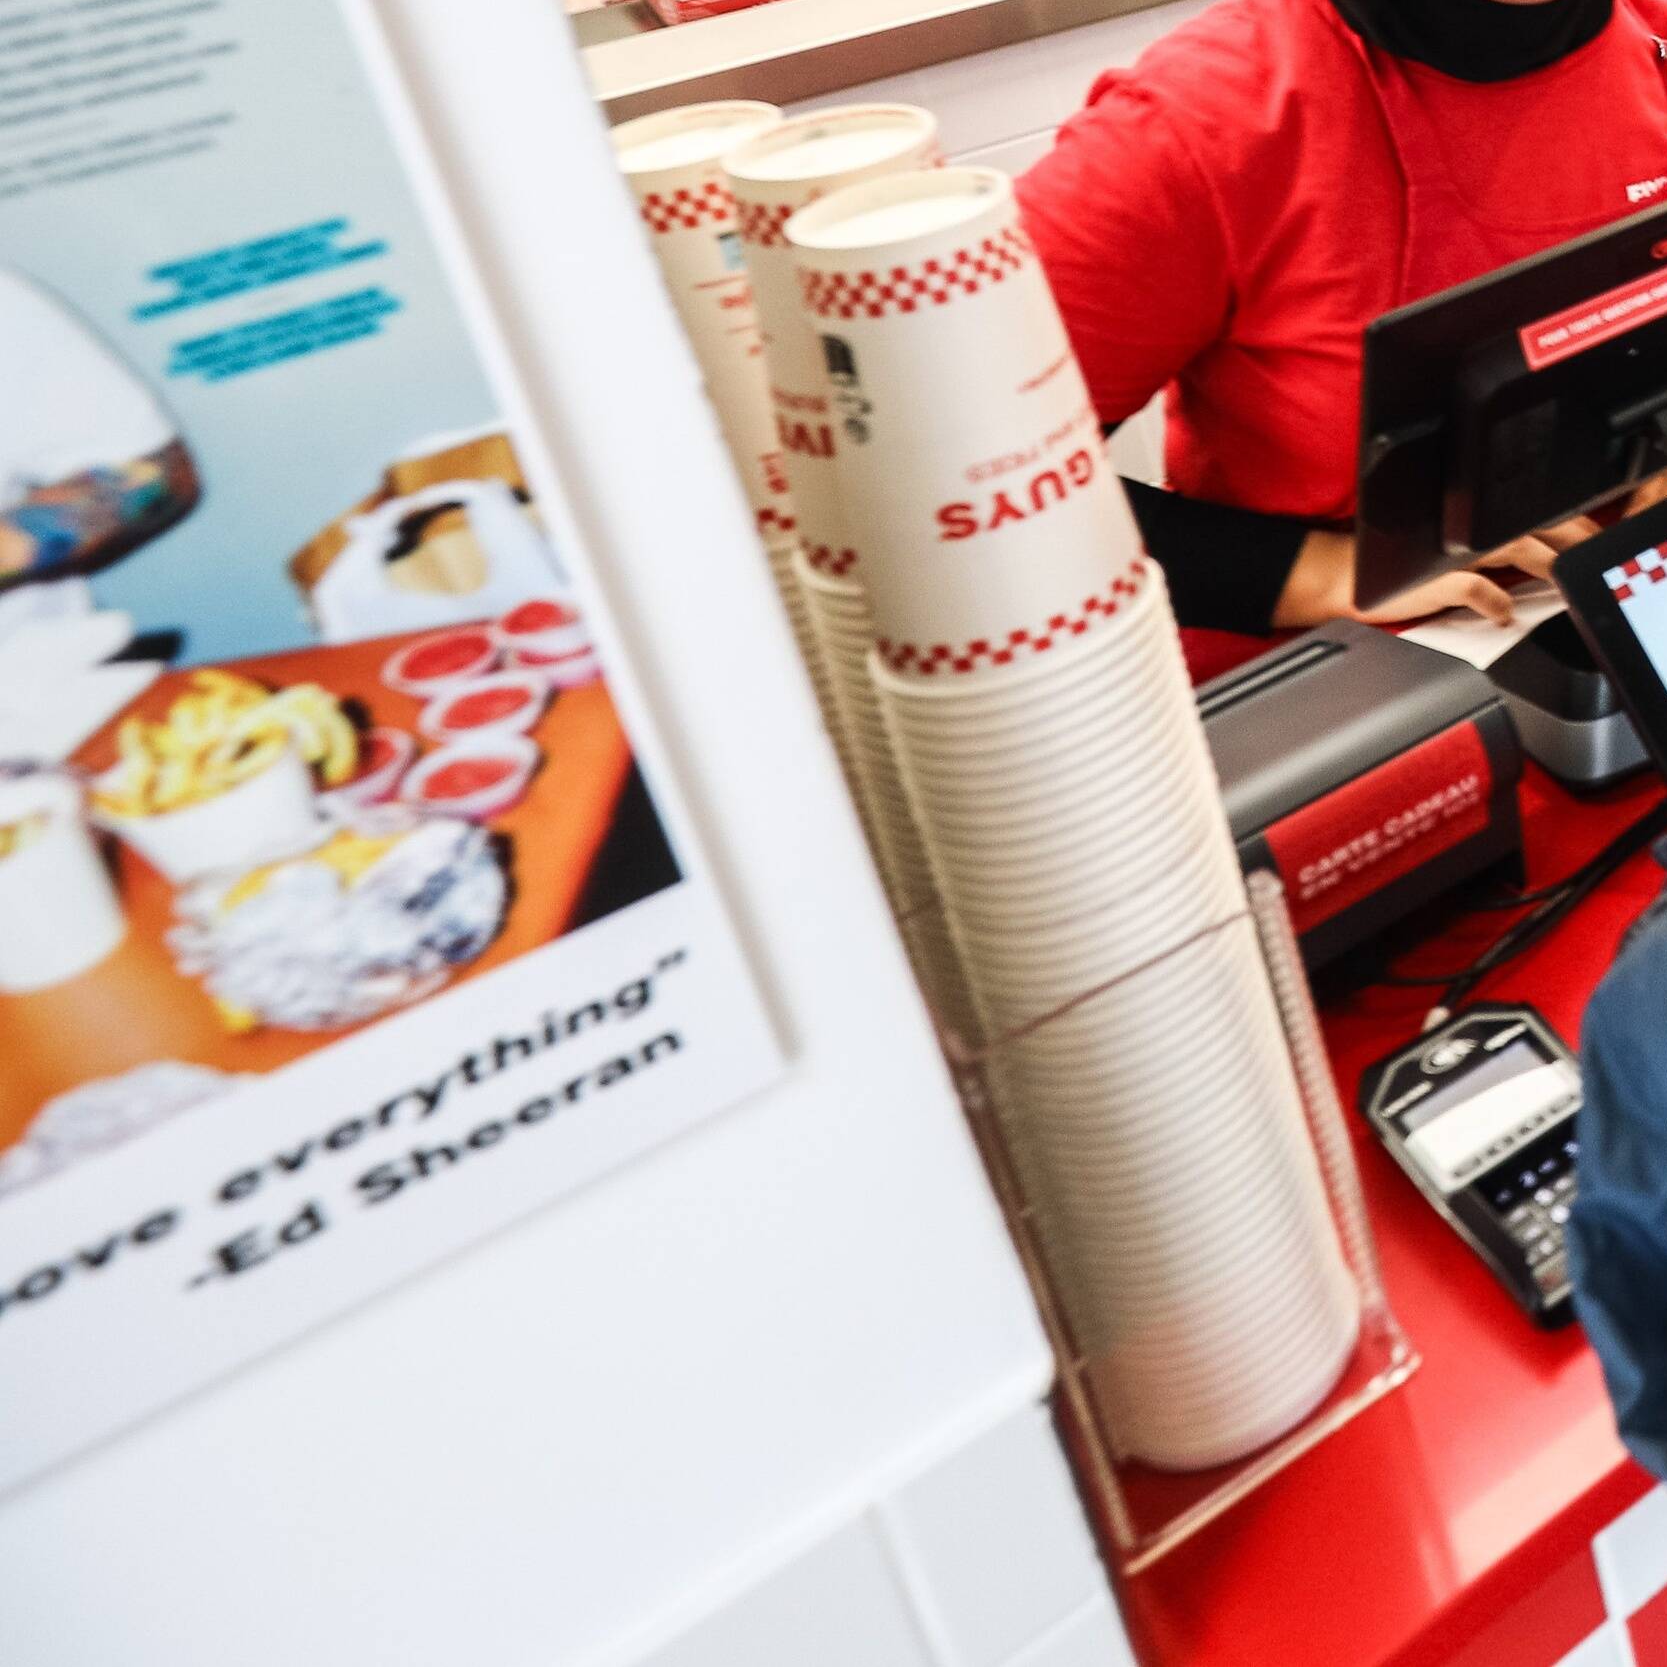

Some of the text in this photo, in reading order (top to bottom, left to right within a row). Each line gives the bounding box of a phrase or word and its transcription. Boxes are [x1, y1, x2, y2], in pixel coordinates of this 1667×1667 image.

[934, 447, 1095, 542] GUYS
[353, 1027, 685, 1211] Sheeran
[0, 1206, 184, 1316] ove
